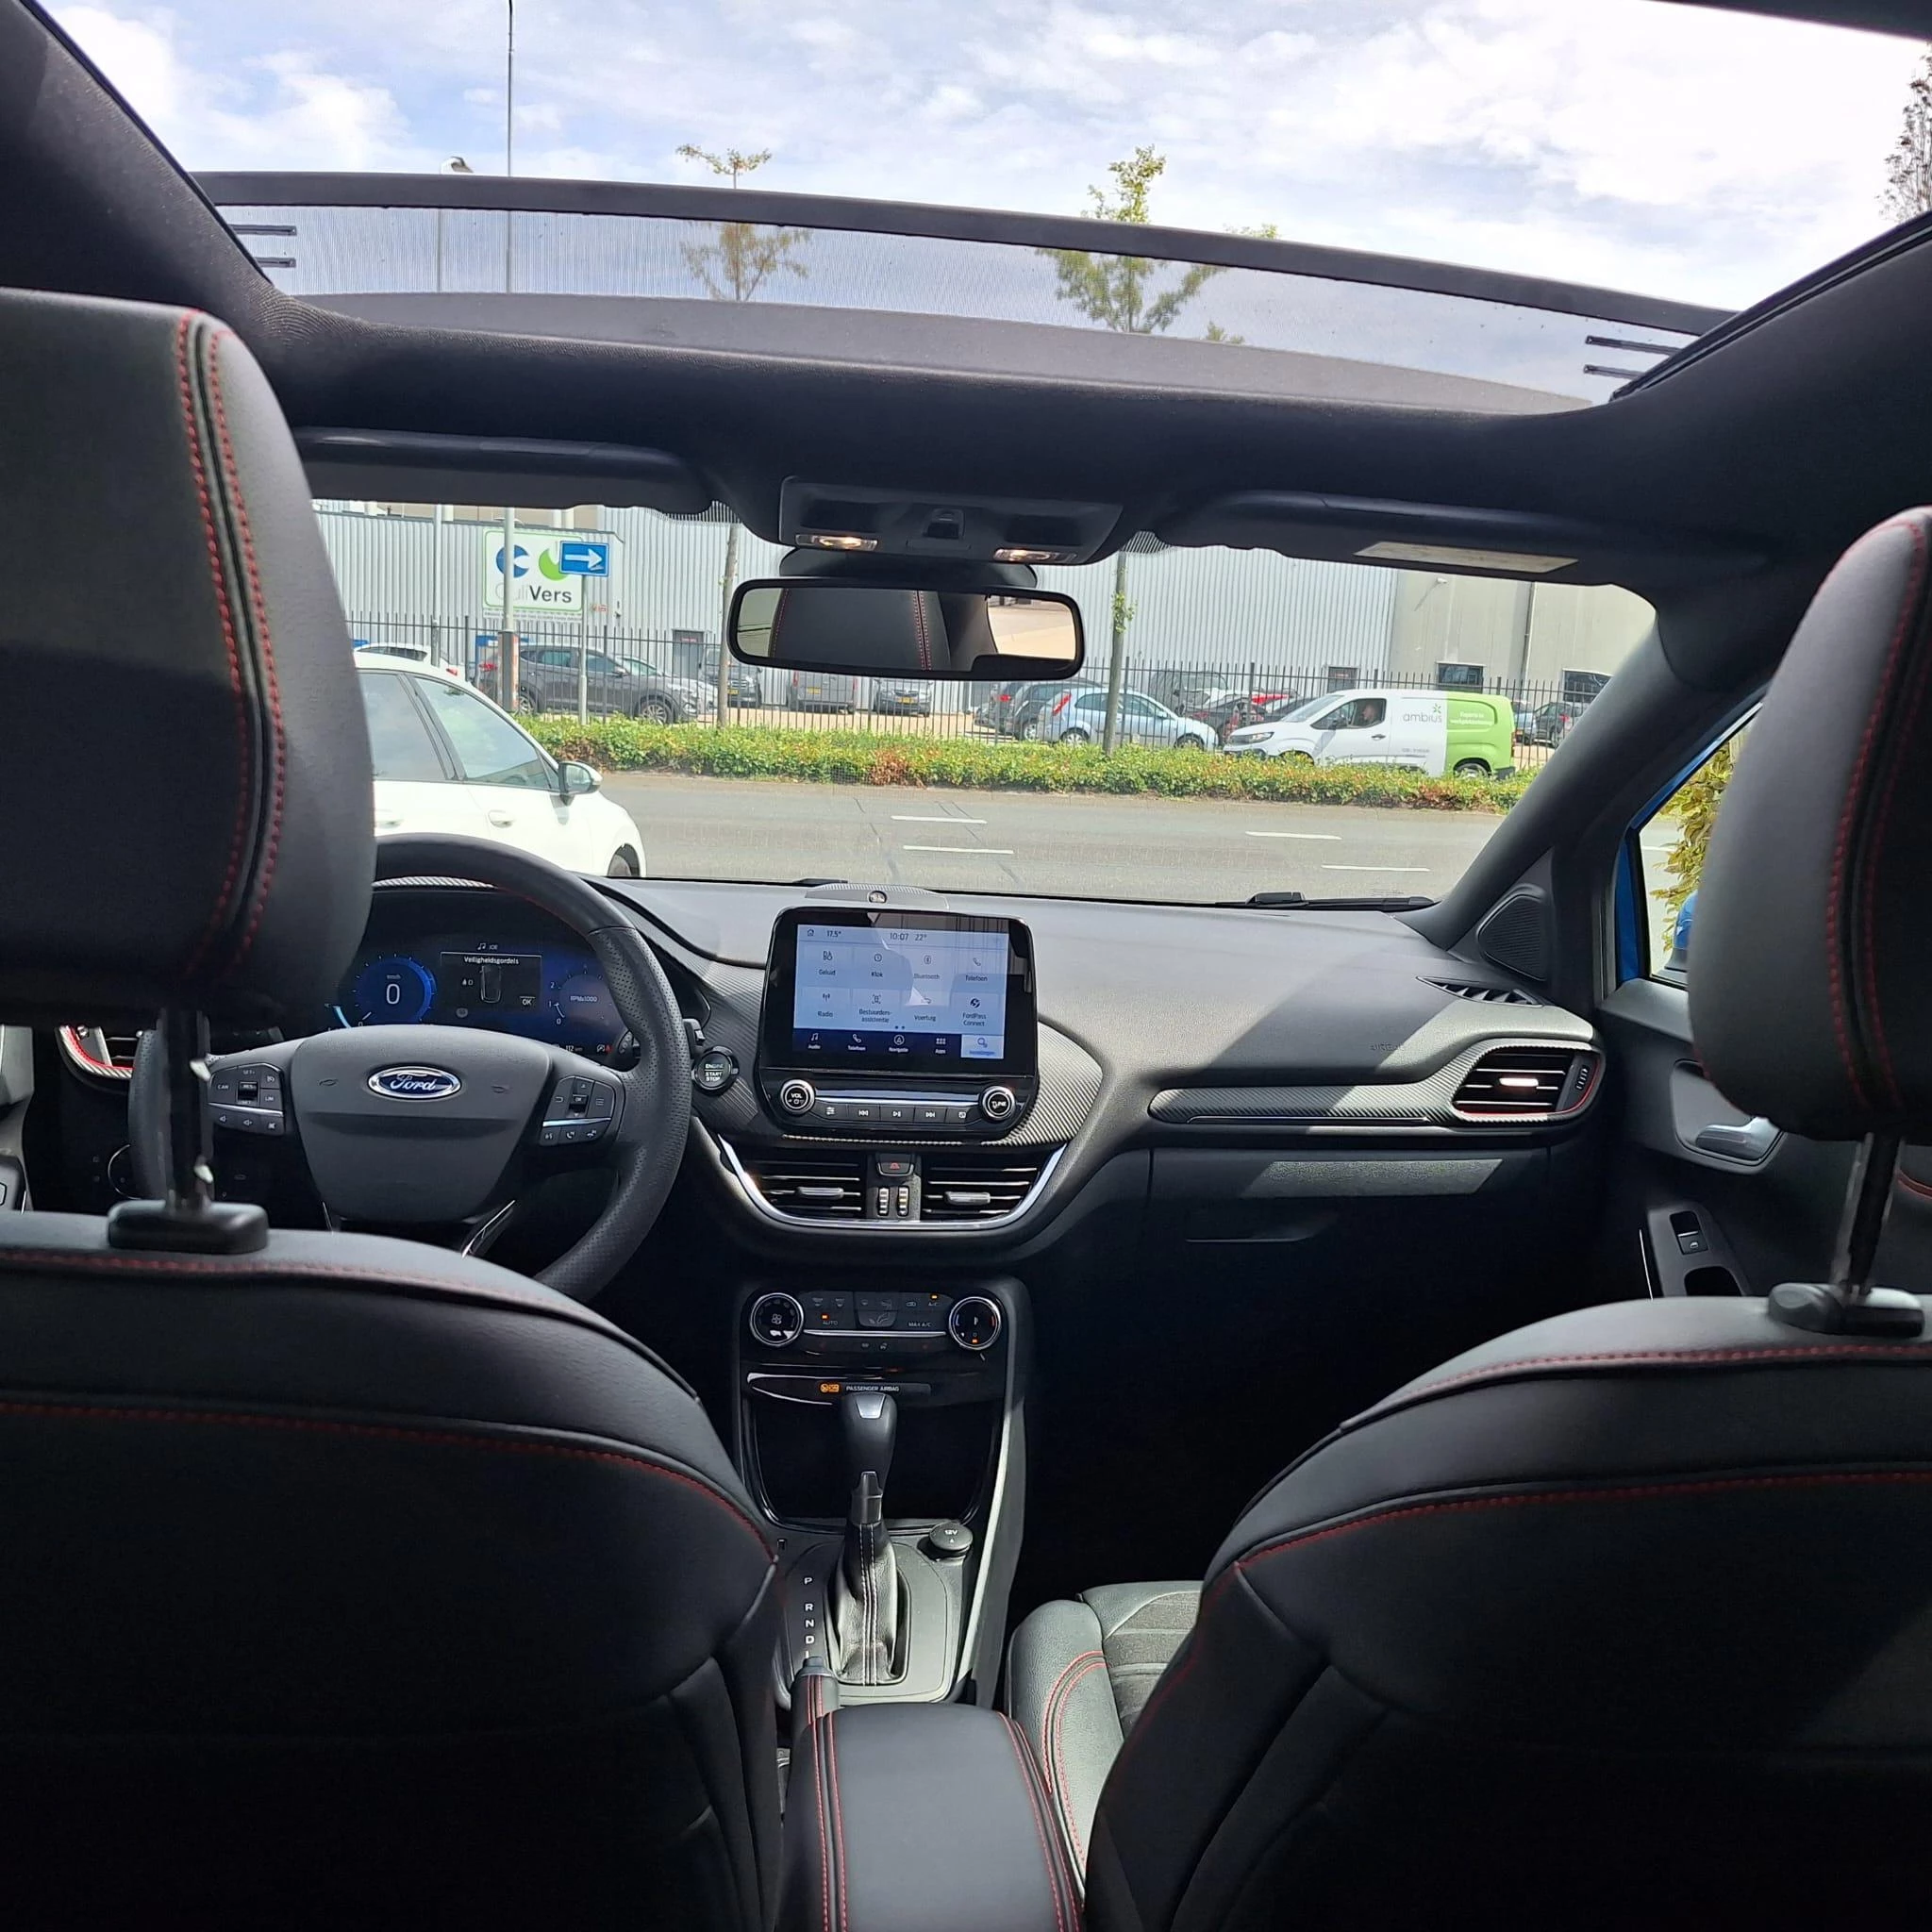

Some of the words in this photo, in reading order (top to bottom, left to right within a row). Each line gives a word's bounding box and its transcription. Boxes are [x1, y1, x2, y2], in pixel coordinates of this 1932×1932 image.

[1403, 711, 1442, 724] ambius
[890, 932, 909, 941] 10:07
[464, 956, 520, 965] Veiligheidsgordels
[818, 968, 837, 977] Geluid
[386, 983, 401, 1005] 0
[522, 998, 533, 1007] OK
[817, 1009, 834, 1019] Radio
[962, 1012, 987, 1021] FordPass
[390, 1074, 438, 1091] Ford
[806, 1635, 814, 1643] D
